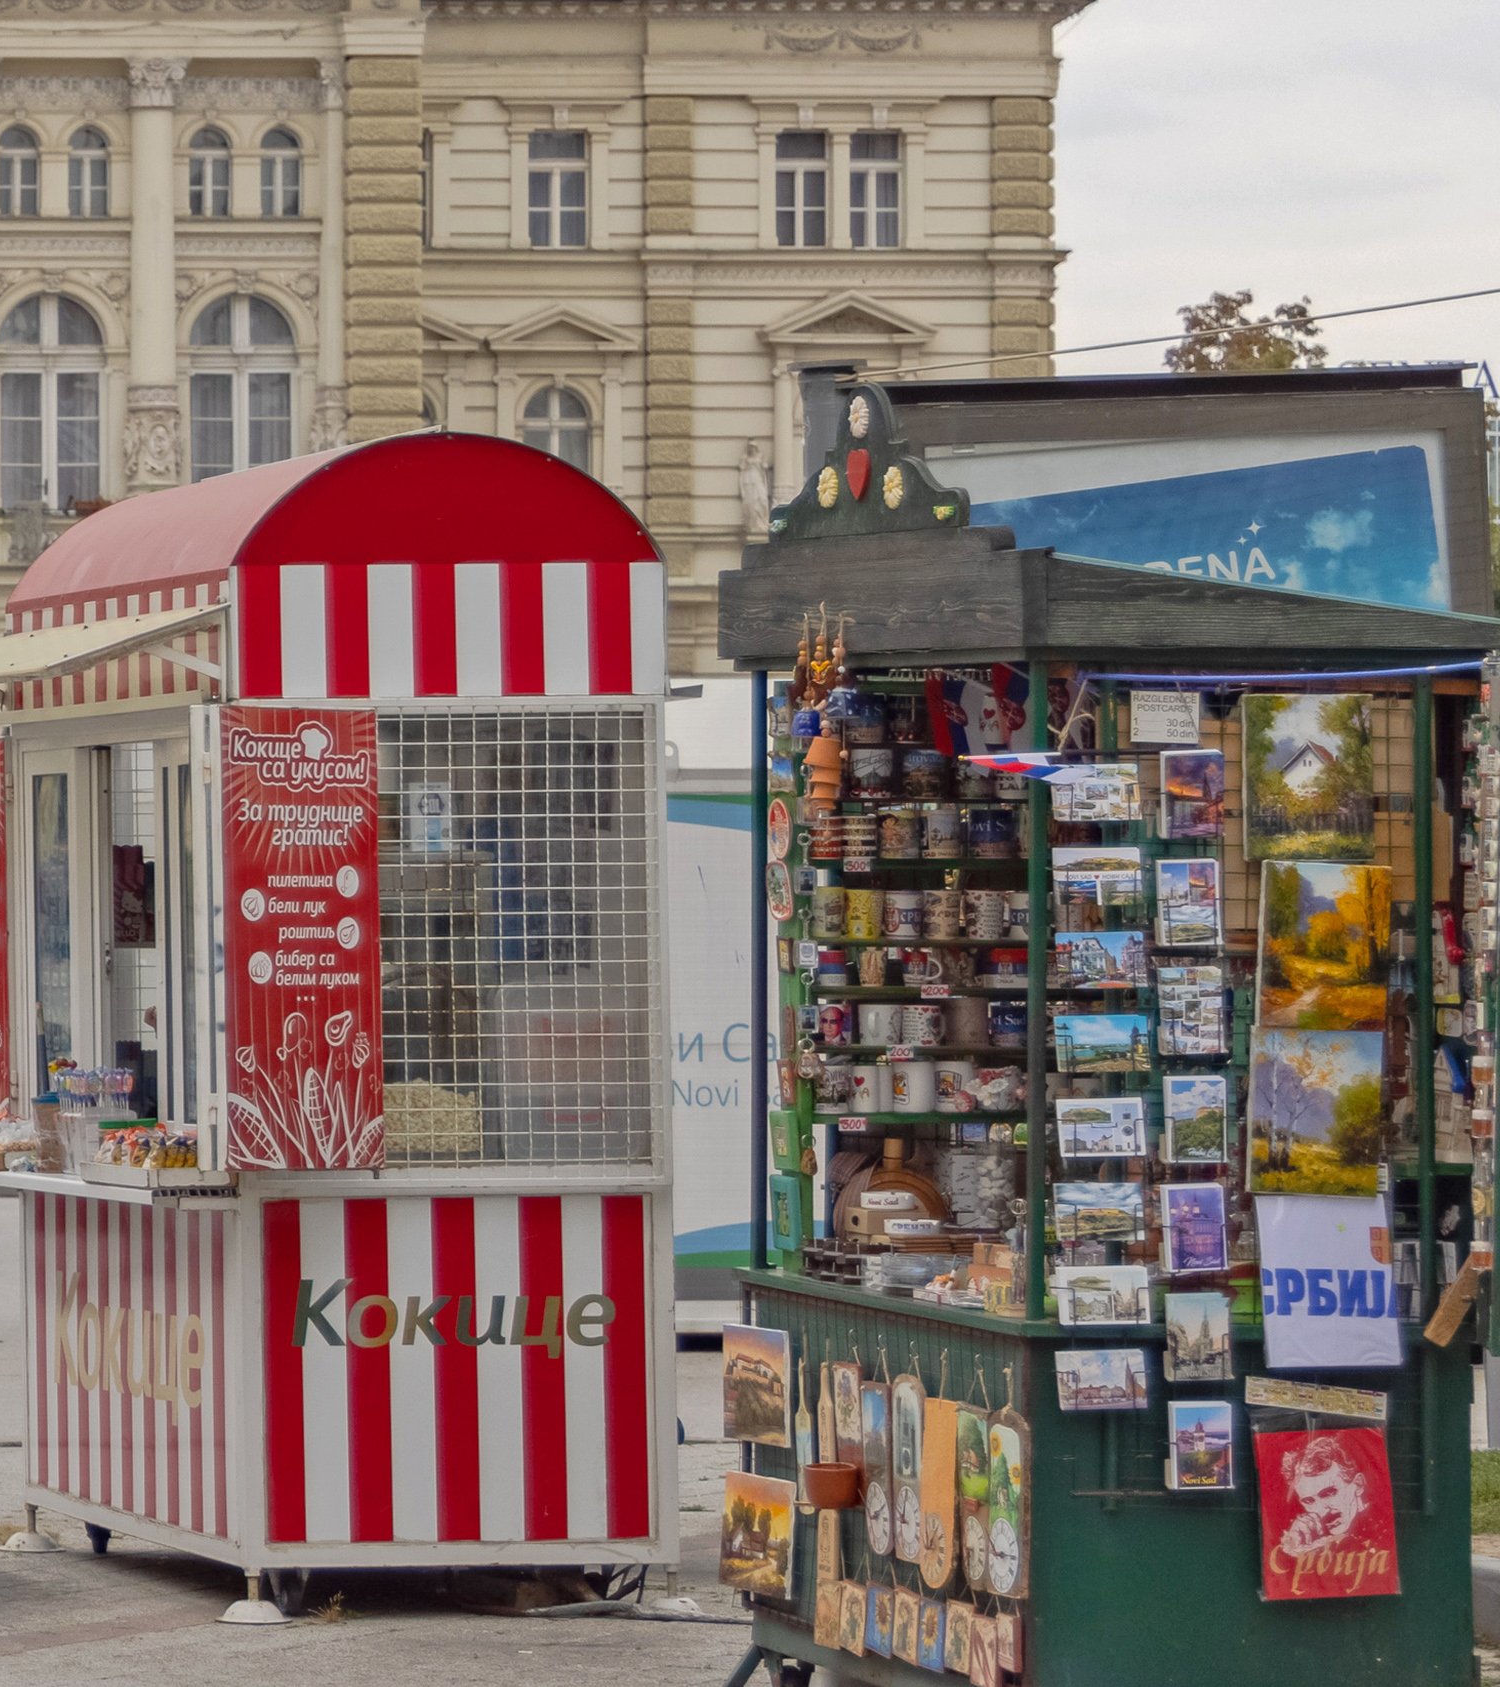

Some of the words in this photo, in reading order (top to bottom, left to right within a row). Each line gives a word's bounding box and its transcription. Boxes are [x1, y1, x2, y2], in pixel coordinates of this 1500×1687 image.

[1133, 693, 1197, 704] RAZGLEDNICE
[1137, 703, 1193, 713] POSTCARDS
[1133, 727, 1139, 736] 2
[1167, 728, 1179, 738] 50
[1166, 718, 1178, 728] 30
[233, 735, 302, 763] Кокице
[262, 761, 285, 779] са
[291, 757, 365, 785] укусом!
[238, 798, 262, 822] За
[268, 804, 364, 828] труднице
[271, 824, 348, 851] гратис!
[267, 875, 334, 888] пилетина
[268, 897, 300, 914] бели
[303, 900, 327, 918] лук
[278, 926, 336, 944] роштиљ
[275, 949, 316, 970] бибер
[319, 953, 335, 966] са
[275, 970, 316, 986] белим
[319, 972, 360, 990] луком
[1261, 1268, 1398, 1319] РБИЈ
[291, 1277, 617, 1359] Кокице
[53, 1270, 206, 1427] Кокице
[1269, 1539, 1390, 1596] Србија
